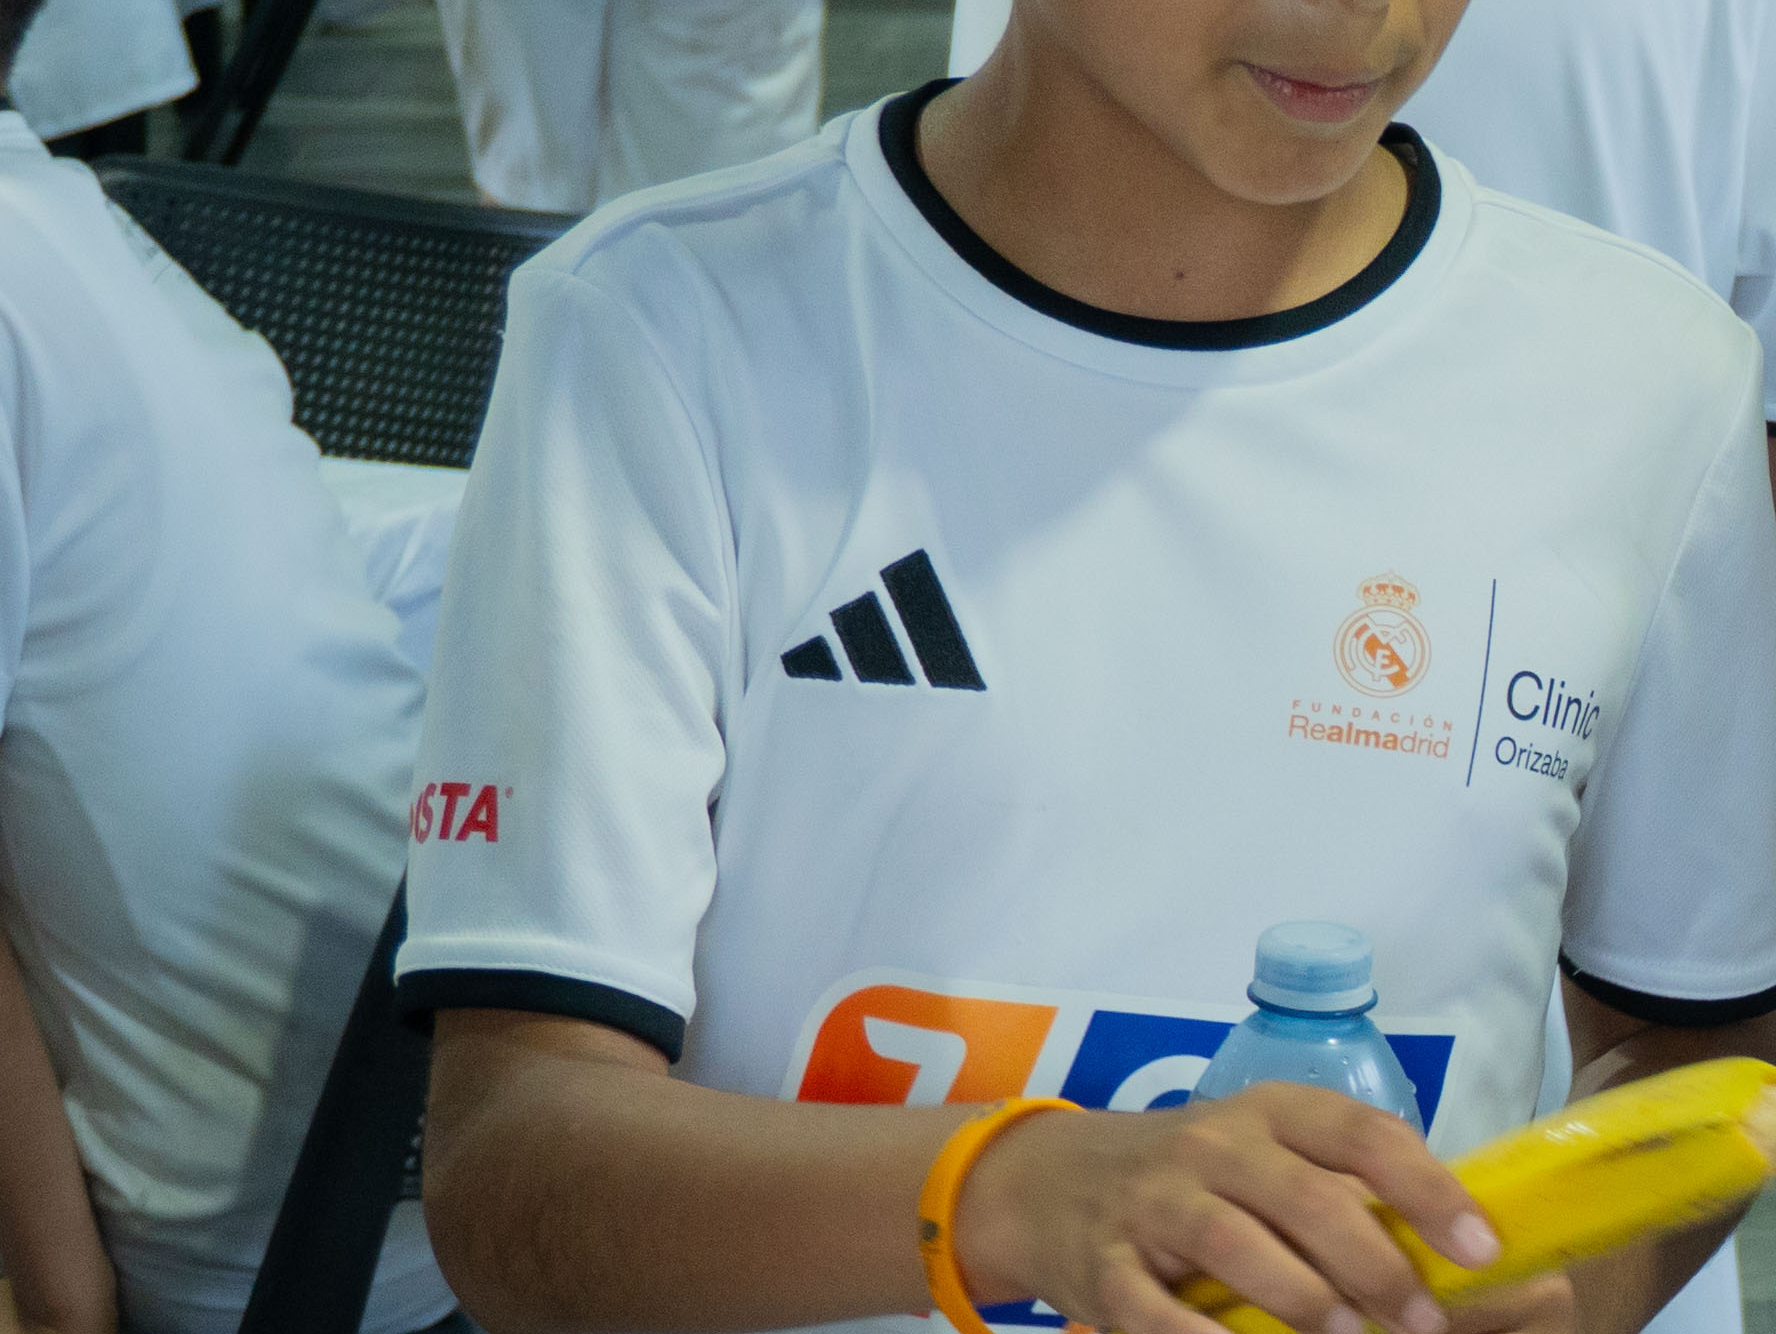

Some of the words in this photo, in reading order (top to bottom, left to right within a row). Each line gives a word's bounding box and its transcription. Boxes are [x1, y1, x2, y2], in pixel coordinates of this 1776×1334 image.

[1291, 699, 1454, 733] FUNDACIÓN
[1506, 669, 1601, 741] Clinic
[1288, 714, 1451, 760] Realmadrid
[1494, 735, 1570, 781] Orizaba
